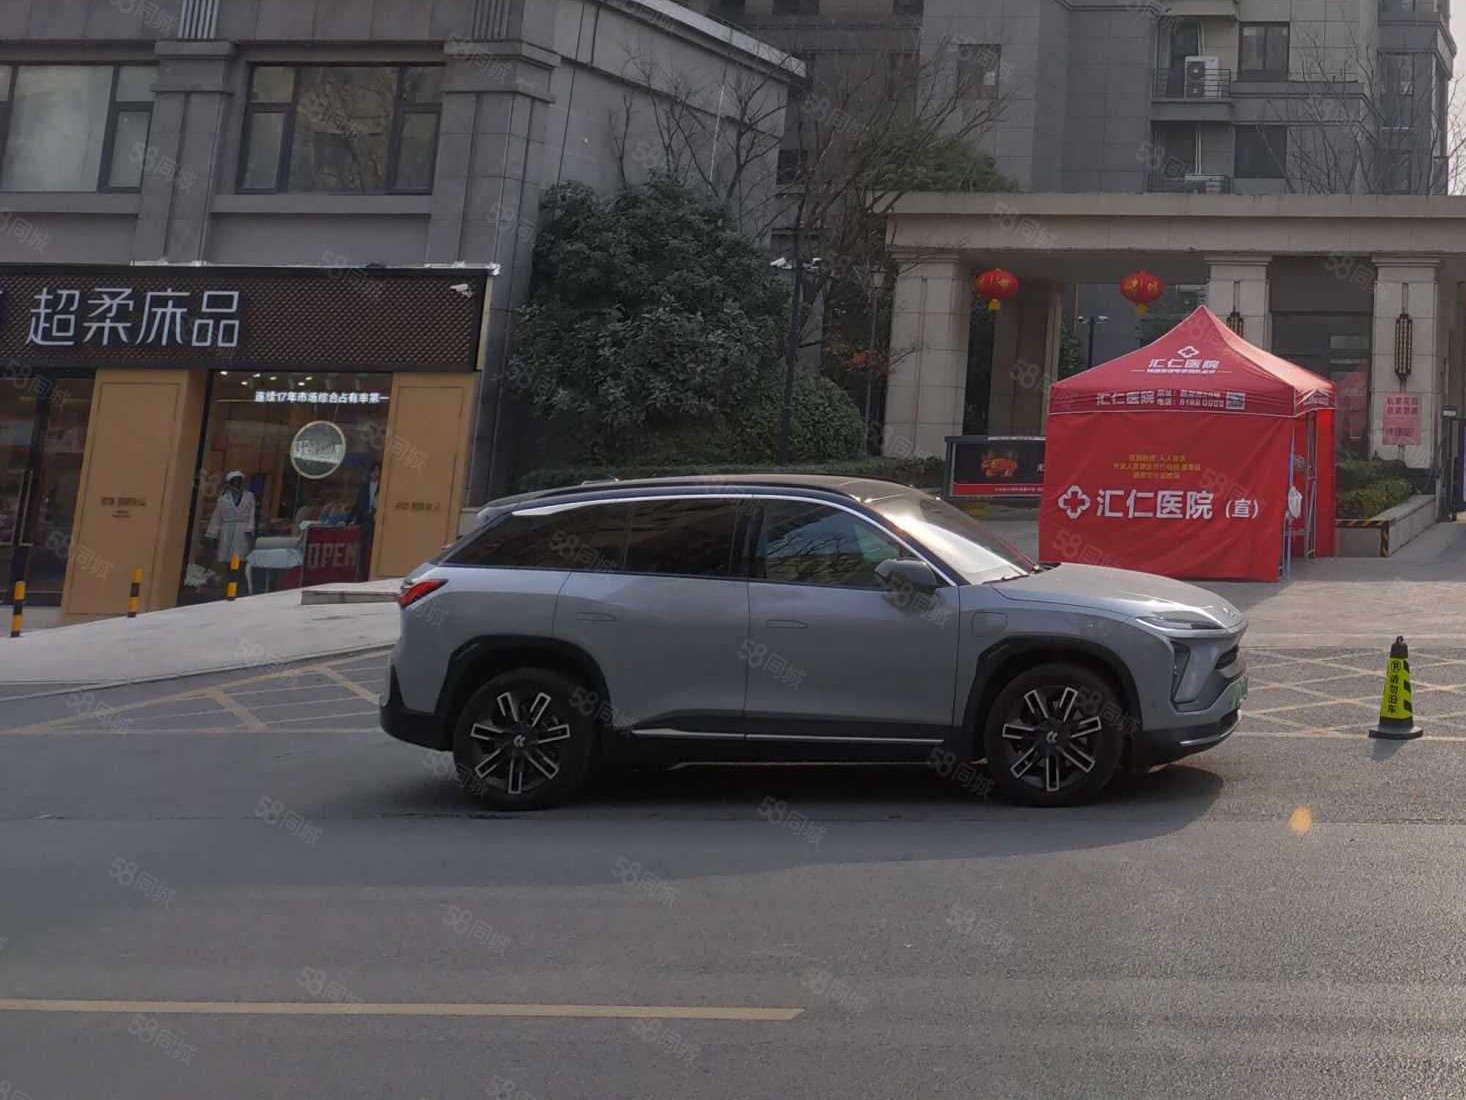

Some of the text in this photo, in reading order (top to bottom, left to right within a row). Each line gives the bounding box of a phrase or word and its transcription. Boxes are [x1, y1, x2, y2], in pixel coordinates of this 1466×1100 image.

[25, 287, 240, 348] 超柔床品
[1148, 358, 1219, 370] 汇仁医院
[1097, 390, 1155, 406] 汇仁医院
[306, 541, 358, 569] OPEN
